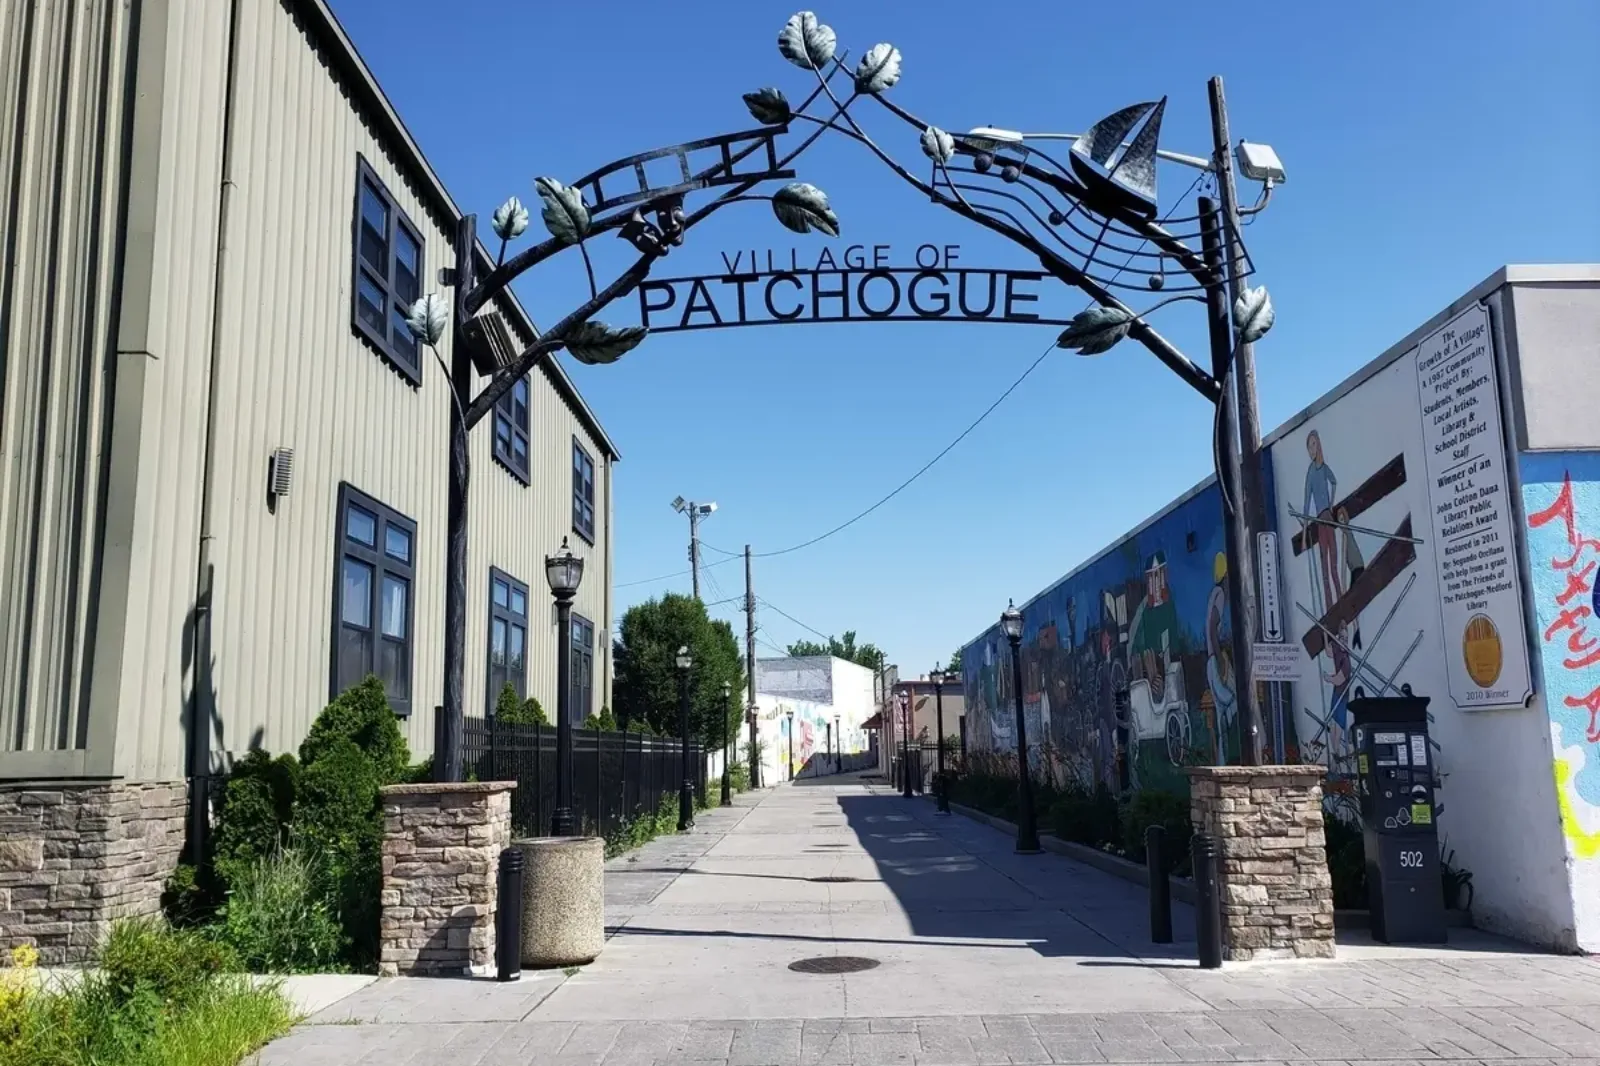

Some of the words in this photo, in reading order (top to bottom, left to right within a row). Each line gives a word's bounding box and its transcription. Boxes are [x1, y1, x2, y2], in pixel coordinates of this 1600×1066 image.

[721, 245, 890, 274] VILLAGE
[915, 244, 960, 270] OF
[639, 270, 1042, 327] PATCHOGUE
[1419, 350, 1442, 371] Growth
[1443, 343, 1451, 356] of
[1459, 324, 1485, 345] Village
[1442, 330, 1455, 343] The
[1428, 368, 1444, 385] 1987
[1445, 345, 1486, 374] Community
[1435, 373, 1459, 393] Project
[1461, 365, 1473, 378] By:
[1434, 407, 1452, 425] Local
[1442, 417, 1467, 436] Library
[1469, 411, 1475, 422] &
[1434, 434, 1458, 454] School
[1459, 421, 1487, 442] District
[1453, 444, 1470, 460] Staff
[1437, 469, 1466, 488] Winner
[1467, 461, 1477, 475] of
[1479, 459, 1491, 470] an
[1454, 479, 1475, 494] A.L.A.
[1436, 502, 1452, 514] John
[1454, 492, 1478, 507] Cotton
[1479, 484, 1499, 498] Dana
[1442, 520, 1474, 537] Relations
[1475, 510, 1498, 526] Award
[1443, 509, 1467, 524] Library
[1469, 500, 1492, 515] Public
[1445, 541, 1472, 556] Restored
[1473, 537, 1480, 546] in
[1481, 532, 1498, 545] 2011
[1442, 571, 1455, 580] with
[1456, 568, 1468, 577] help
[1469, 564, 1484, 573] from
[1490, 557, 1508, 570] grant
[1452, 553, 1478, 566] Segundo
[1447, 582, 1461, 591] from
[1462, 579, 1472, 588] The
[1473, 572, 1496, 585] Friends
[1497, 569, 1505, 578] of
[1443, 596, 1454, 604] The
[1455, 581, 1513, 601] Patchogue-Medford
[1466, 600, 1488, 611] Library
[1466, 691, 1483, 700] 2010
[1486, 690, 1509, 699] Winner
[1400, 851, 1424, 867] 502
